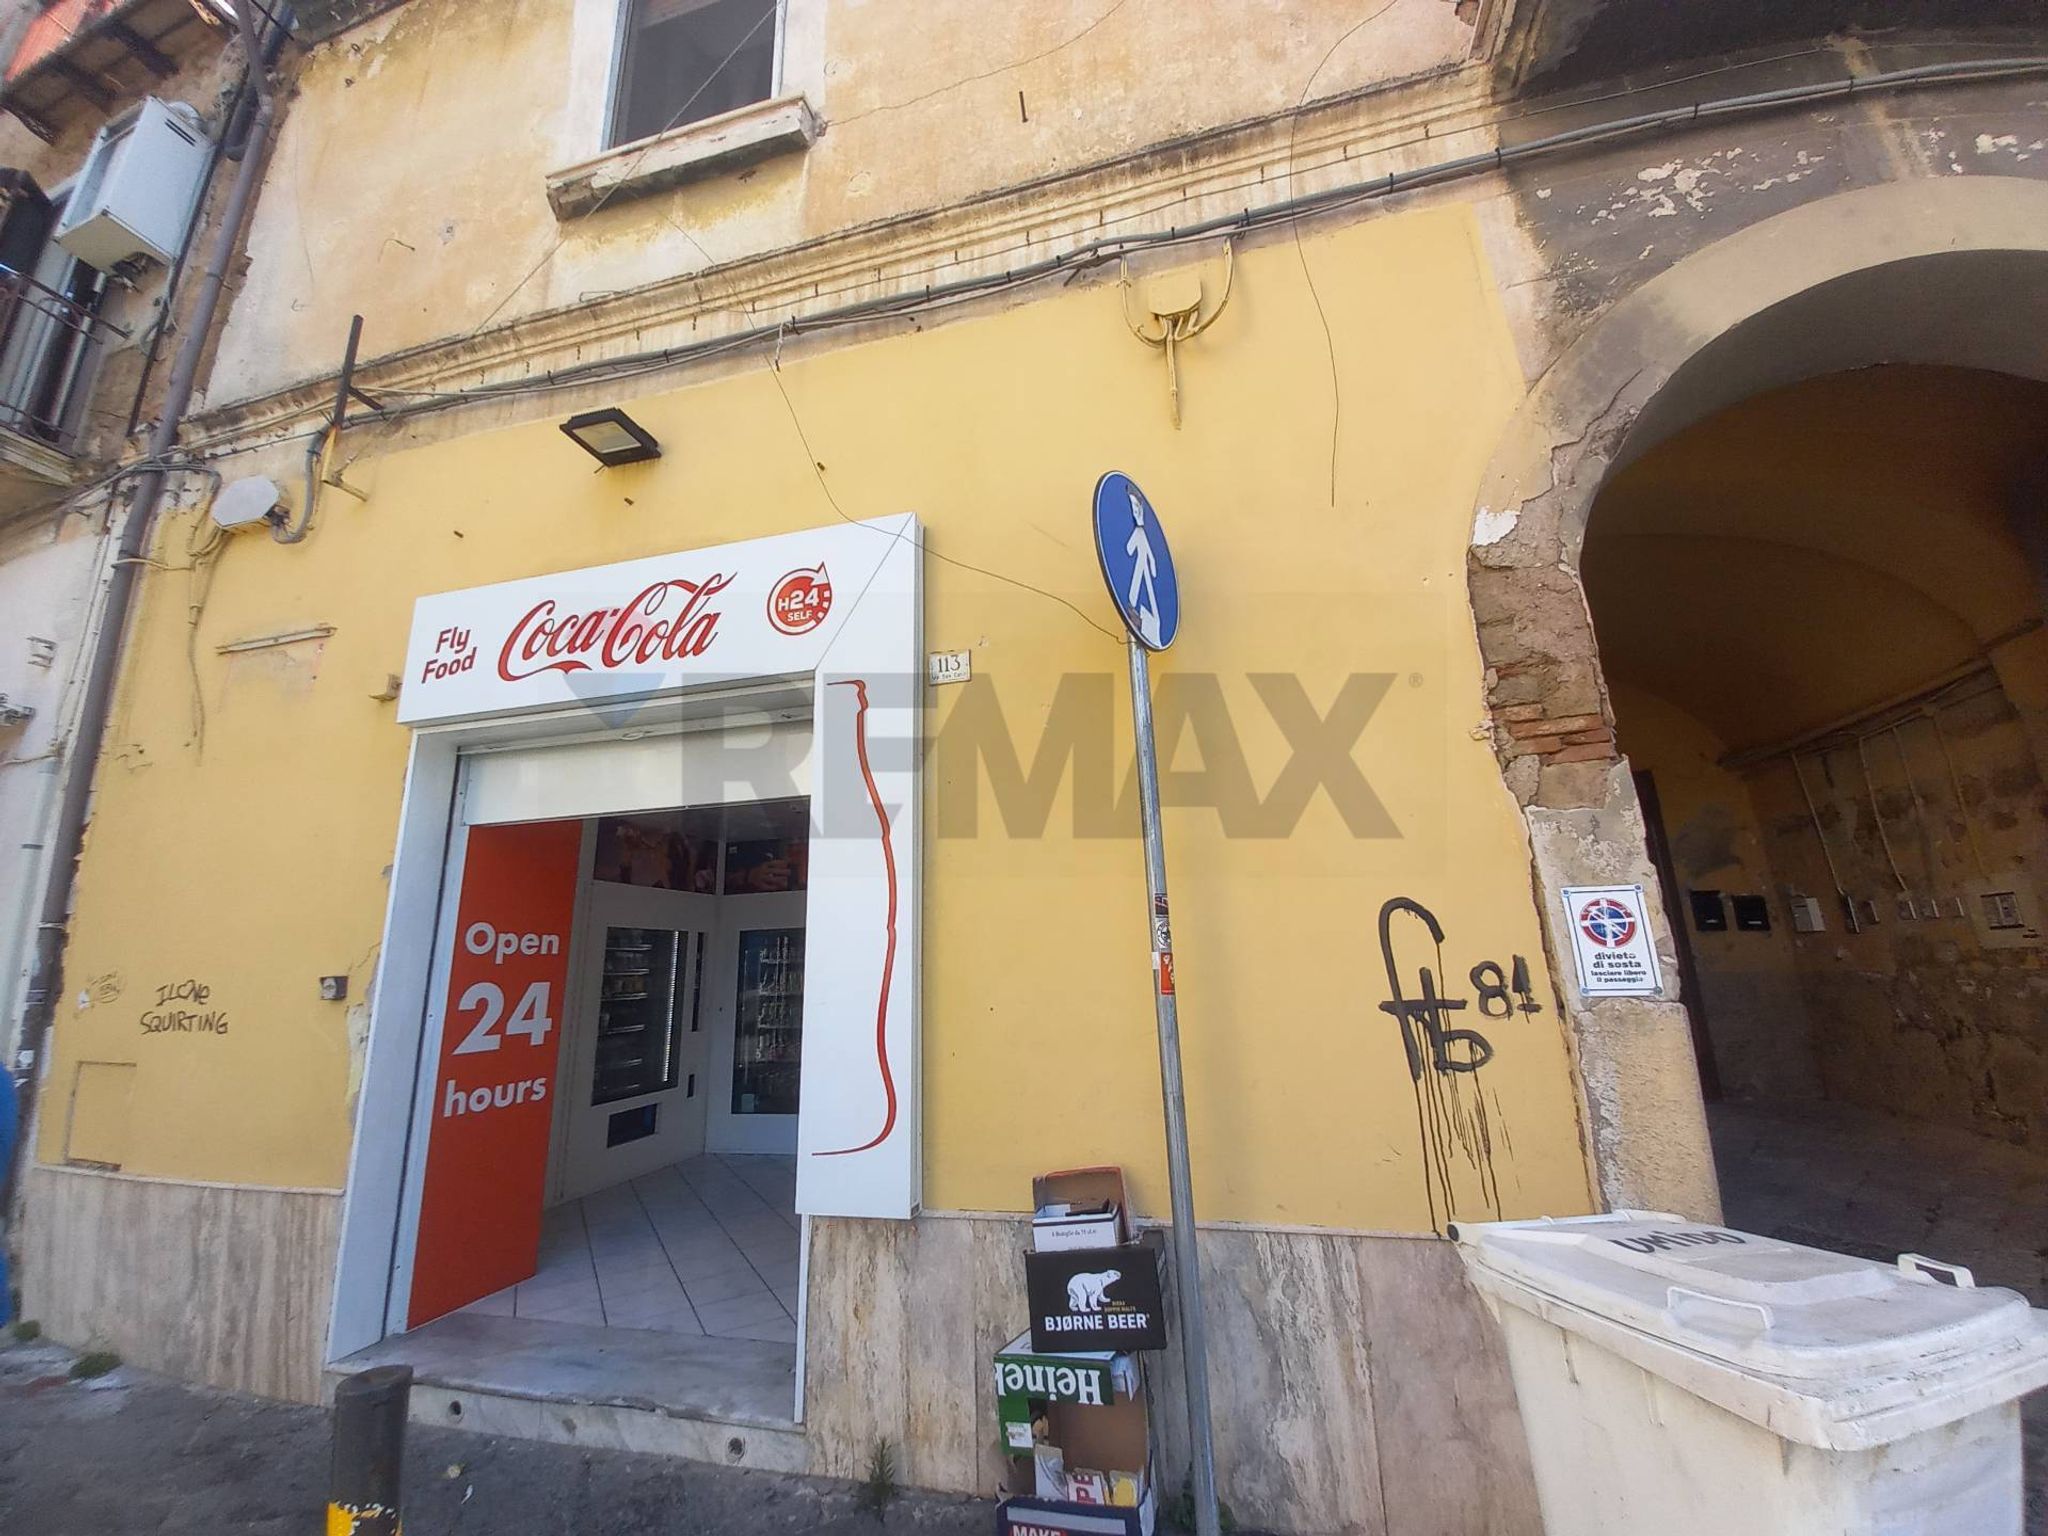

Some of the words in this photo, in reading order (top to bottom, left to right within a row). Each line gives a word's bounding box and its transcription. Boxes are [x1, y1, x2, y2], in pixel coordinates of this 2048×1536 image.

[778, 587, 820, 612] H24
[787, 609, 813, 622] SELF
[435, 626, 471, 654] Fly
[421, 653, 476, 684] Food
[938, 654, 961, 673] 113
[465, 921, 561, 965] Open
[1594, 951, 1637, 960] divieto
[1593, 960, 1605, 969] di
[1607, 960, 1642, 969] sosta
[140, 1010, 229, 1035] SQUIRTING
[452, 981, 553, 1056] 24
[443, 1077, 548, 1118] hours
[1044, 1314, 1103, 1332] BJØRNE
[1108, 1313, 1147, 1330] BEER
